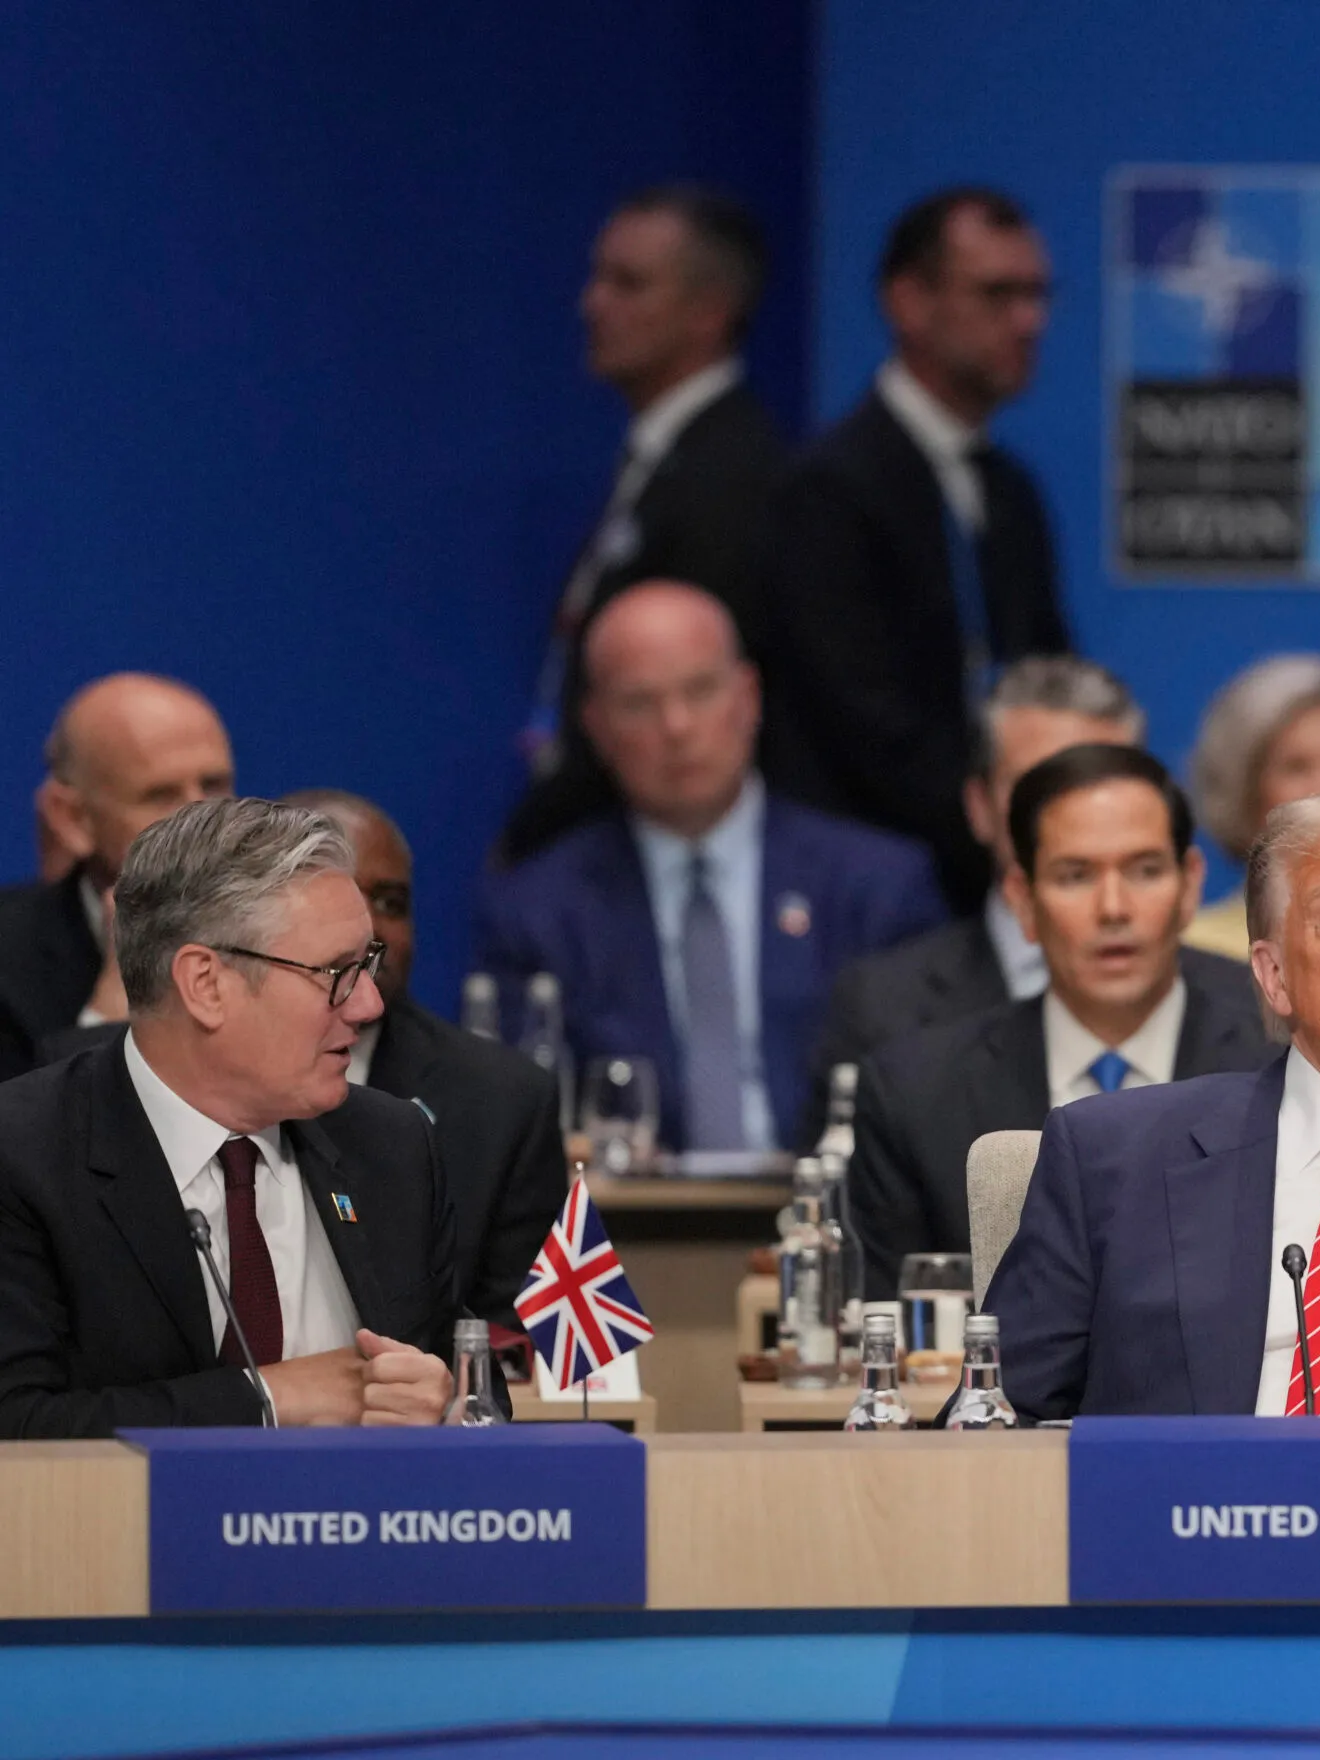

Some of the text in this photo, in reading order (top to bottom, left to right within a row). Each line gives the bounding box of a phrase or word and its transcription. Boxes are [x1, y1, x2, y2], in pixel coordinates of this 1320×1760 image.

[222, 1508, 572, 1546] UNITED KINGDOM
[1171, 1504, 1319, 1539] UNITED
